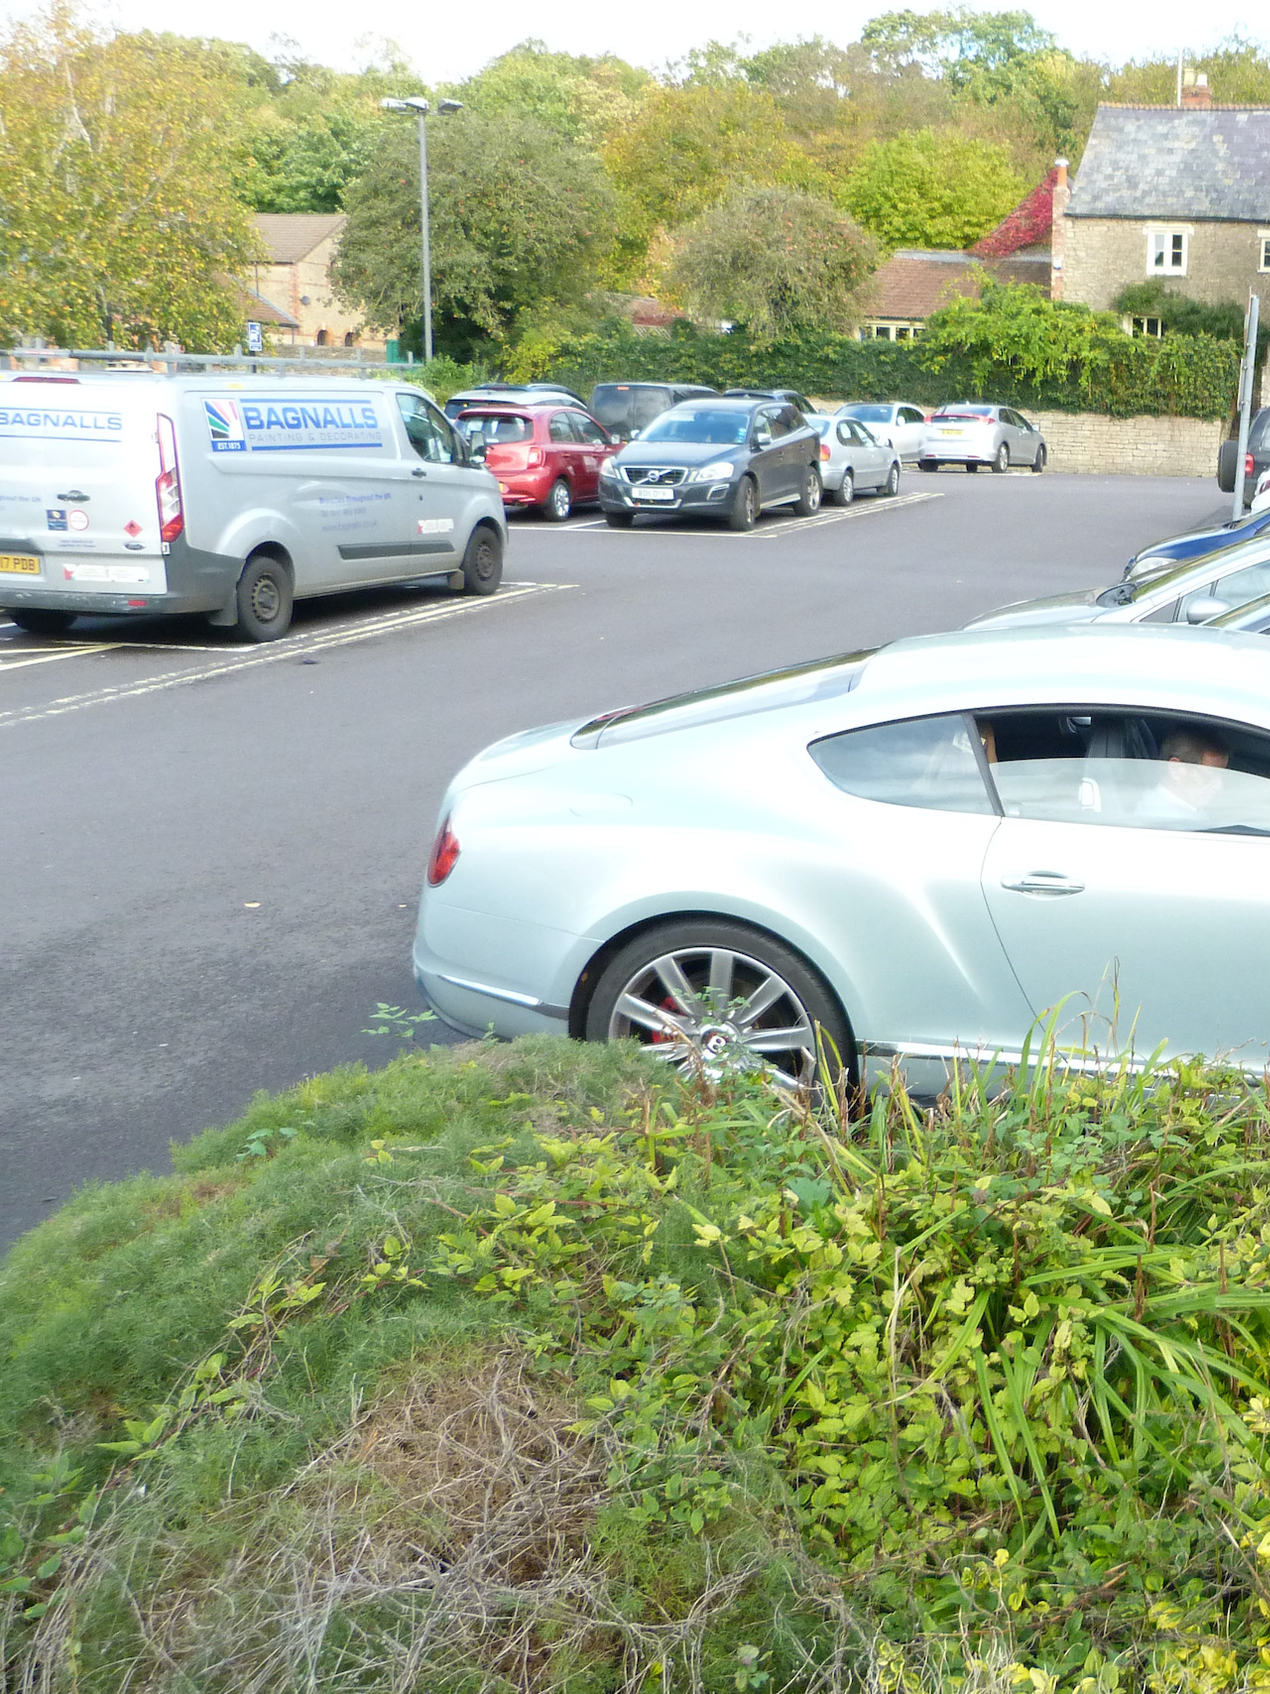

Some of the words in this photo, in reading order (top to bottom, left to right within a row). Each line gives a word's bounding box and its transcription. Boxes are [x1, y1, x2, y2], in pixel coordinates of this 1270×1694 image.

[243, 407, 378, 429] BAGNALLS
[249, 431, 303, 443] PAINTING
[320, 430, 382, 441] DECORATING
[13, 557, 34, 570] PDB
